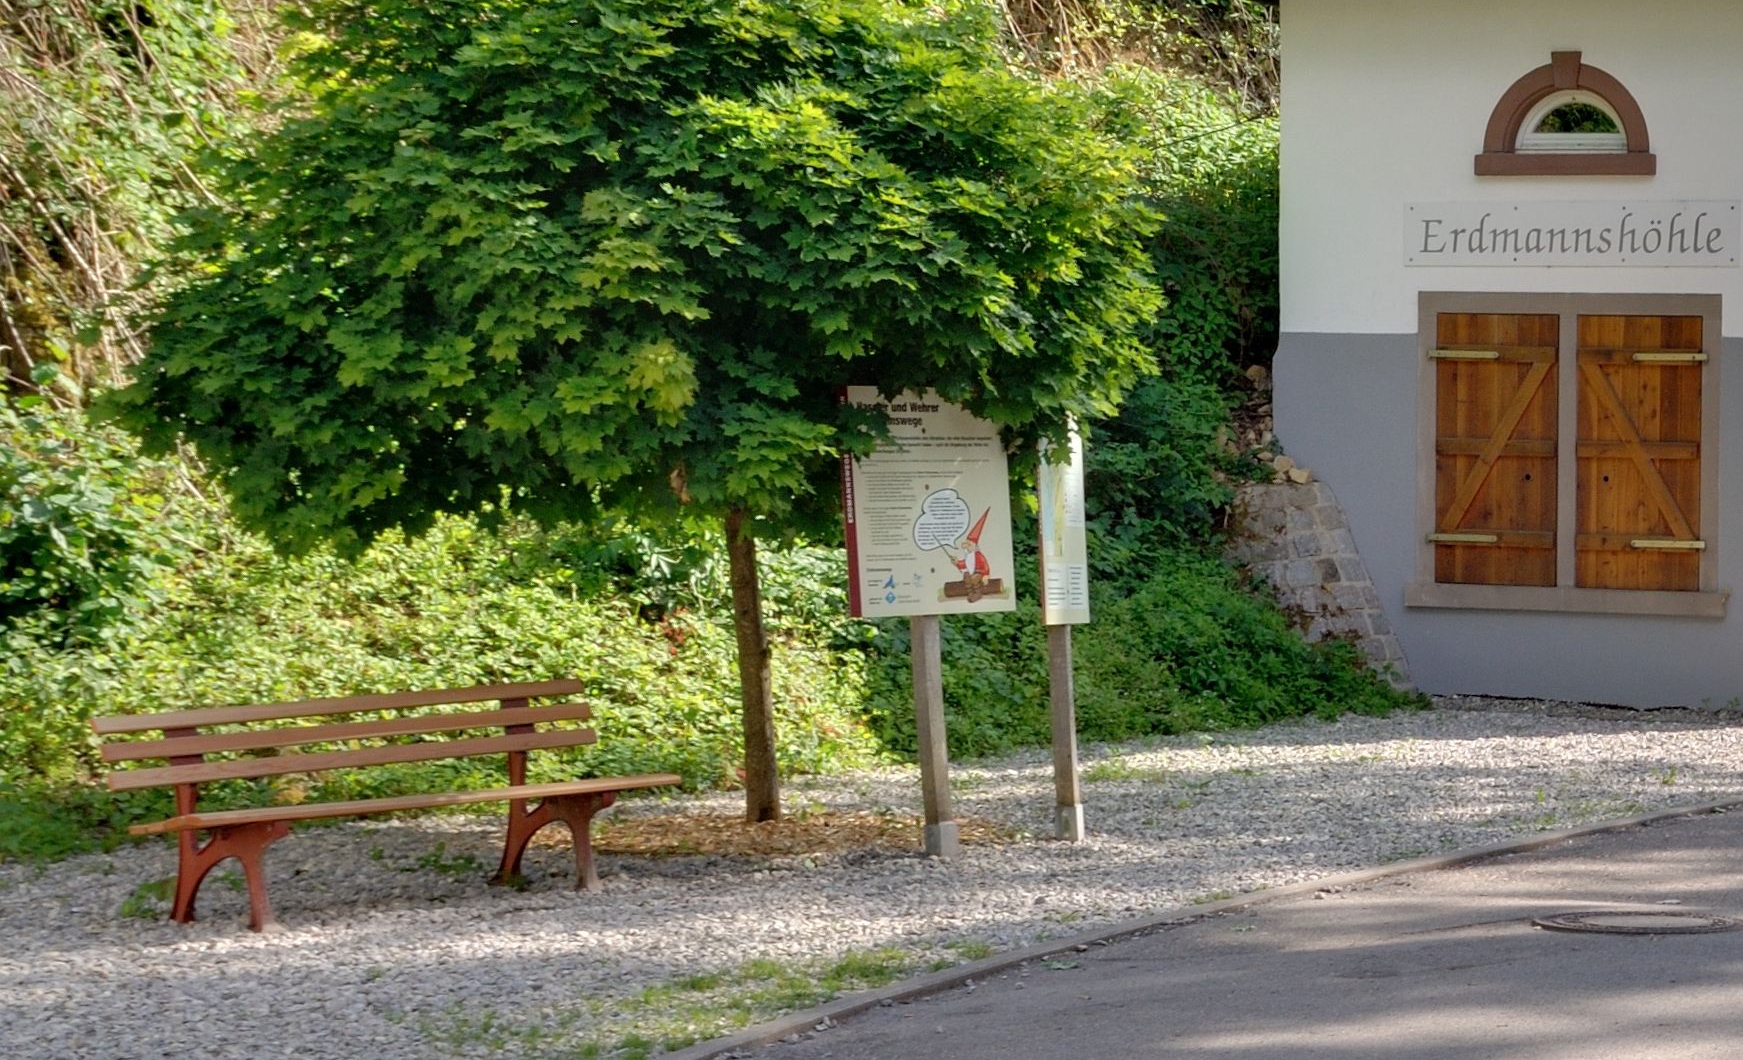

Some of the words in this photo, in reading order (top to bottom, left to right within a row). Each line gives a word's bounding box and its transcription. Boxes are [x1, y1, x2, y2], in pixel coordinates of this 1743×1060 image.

[1419, 212, 1724, 254] Erdmannshöhle
[891, 402, 907, 412] und
[910, 402, 939, 412] Wehrer
